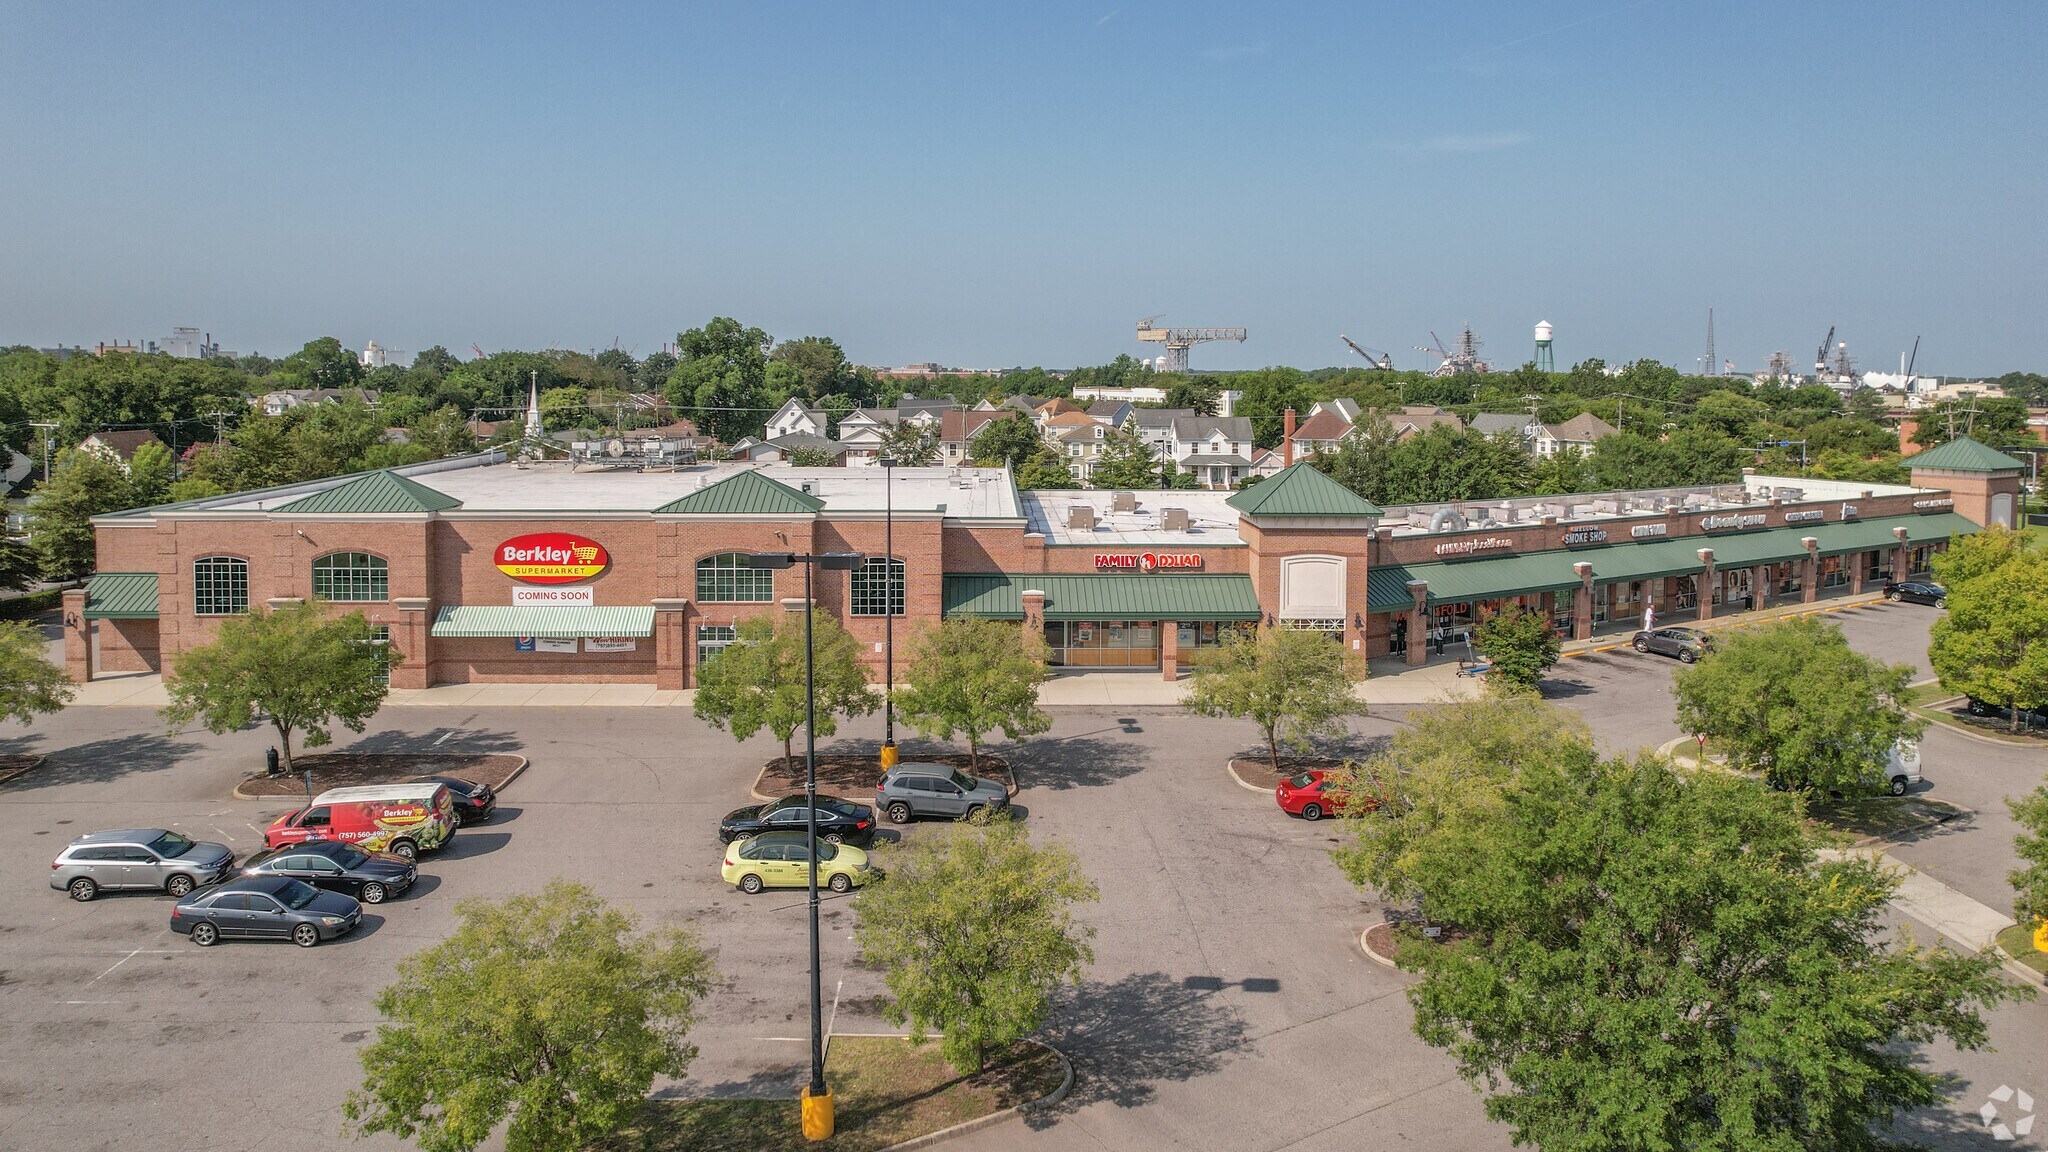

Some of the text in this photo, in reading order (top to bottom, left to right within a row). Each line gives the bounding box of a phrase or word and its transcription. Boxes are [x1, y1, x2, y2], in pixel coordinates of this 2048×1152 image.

[1564, 531, 1607, 544] SMOKE SHOP
[503, 546, 572, 565] Berkley
[1094, 554, 1202, 567] FAMILY DOLLAR
[515, 567, 585, 575] SUPERMARKET
[518, 591, 589, 601] COMING SOON
[1441, 603, 1468, 616] FOLD
[384, 809, 413, 818] Berkley
[338, 830, 389, 840] (757) 560-4997
